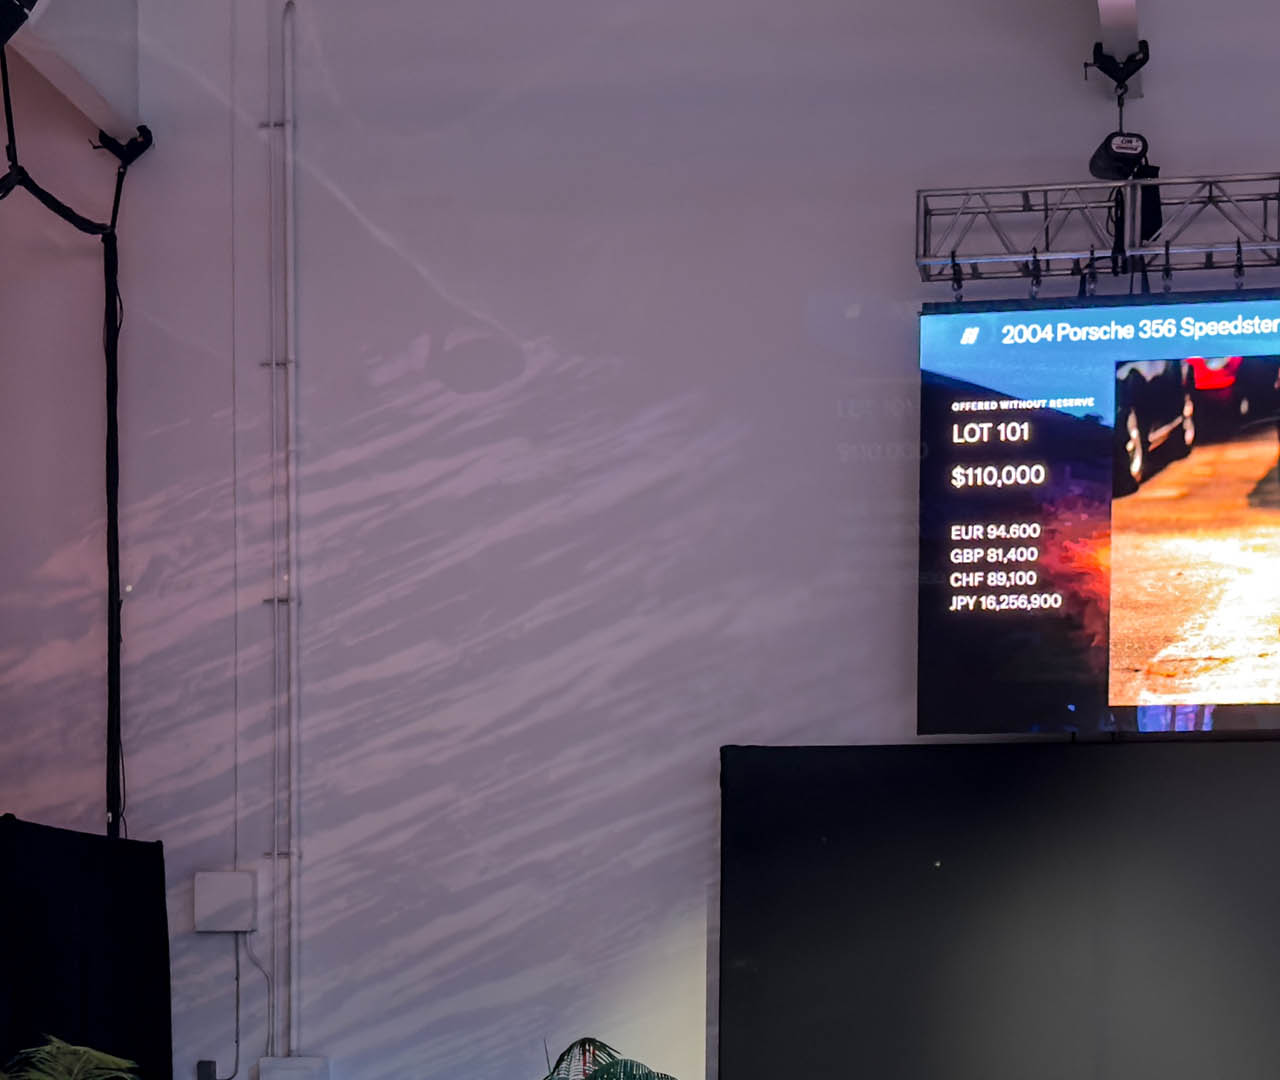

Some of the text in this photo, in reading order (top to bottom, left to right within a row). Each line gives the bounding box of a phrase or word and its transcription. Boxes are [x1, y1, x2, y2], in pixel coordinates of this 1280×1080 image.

[1001, 324, 1054, 345] 2004
[1056, 320, 1134, 342] Porsche
[1138, 319, 1176, 338] 356
[1179, 314, 1280, 341] Speedster
[951, 397, 1095, 412] OFFERED WITHOUT RESERVE
[952, 421, 1030, 444] LOT 101
[951, 464, 1046, 489] $110,000
[951, 524, 984, 540] EUR
[950, 546, 1039, 564] GBP 81,400
[949, 570, 1038, 588] CHF 89,100
[949, 593, 1062, 612] JPY 16,256,900
